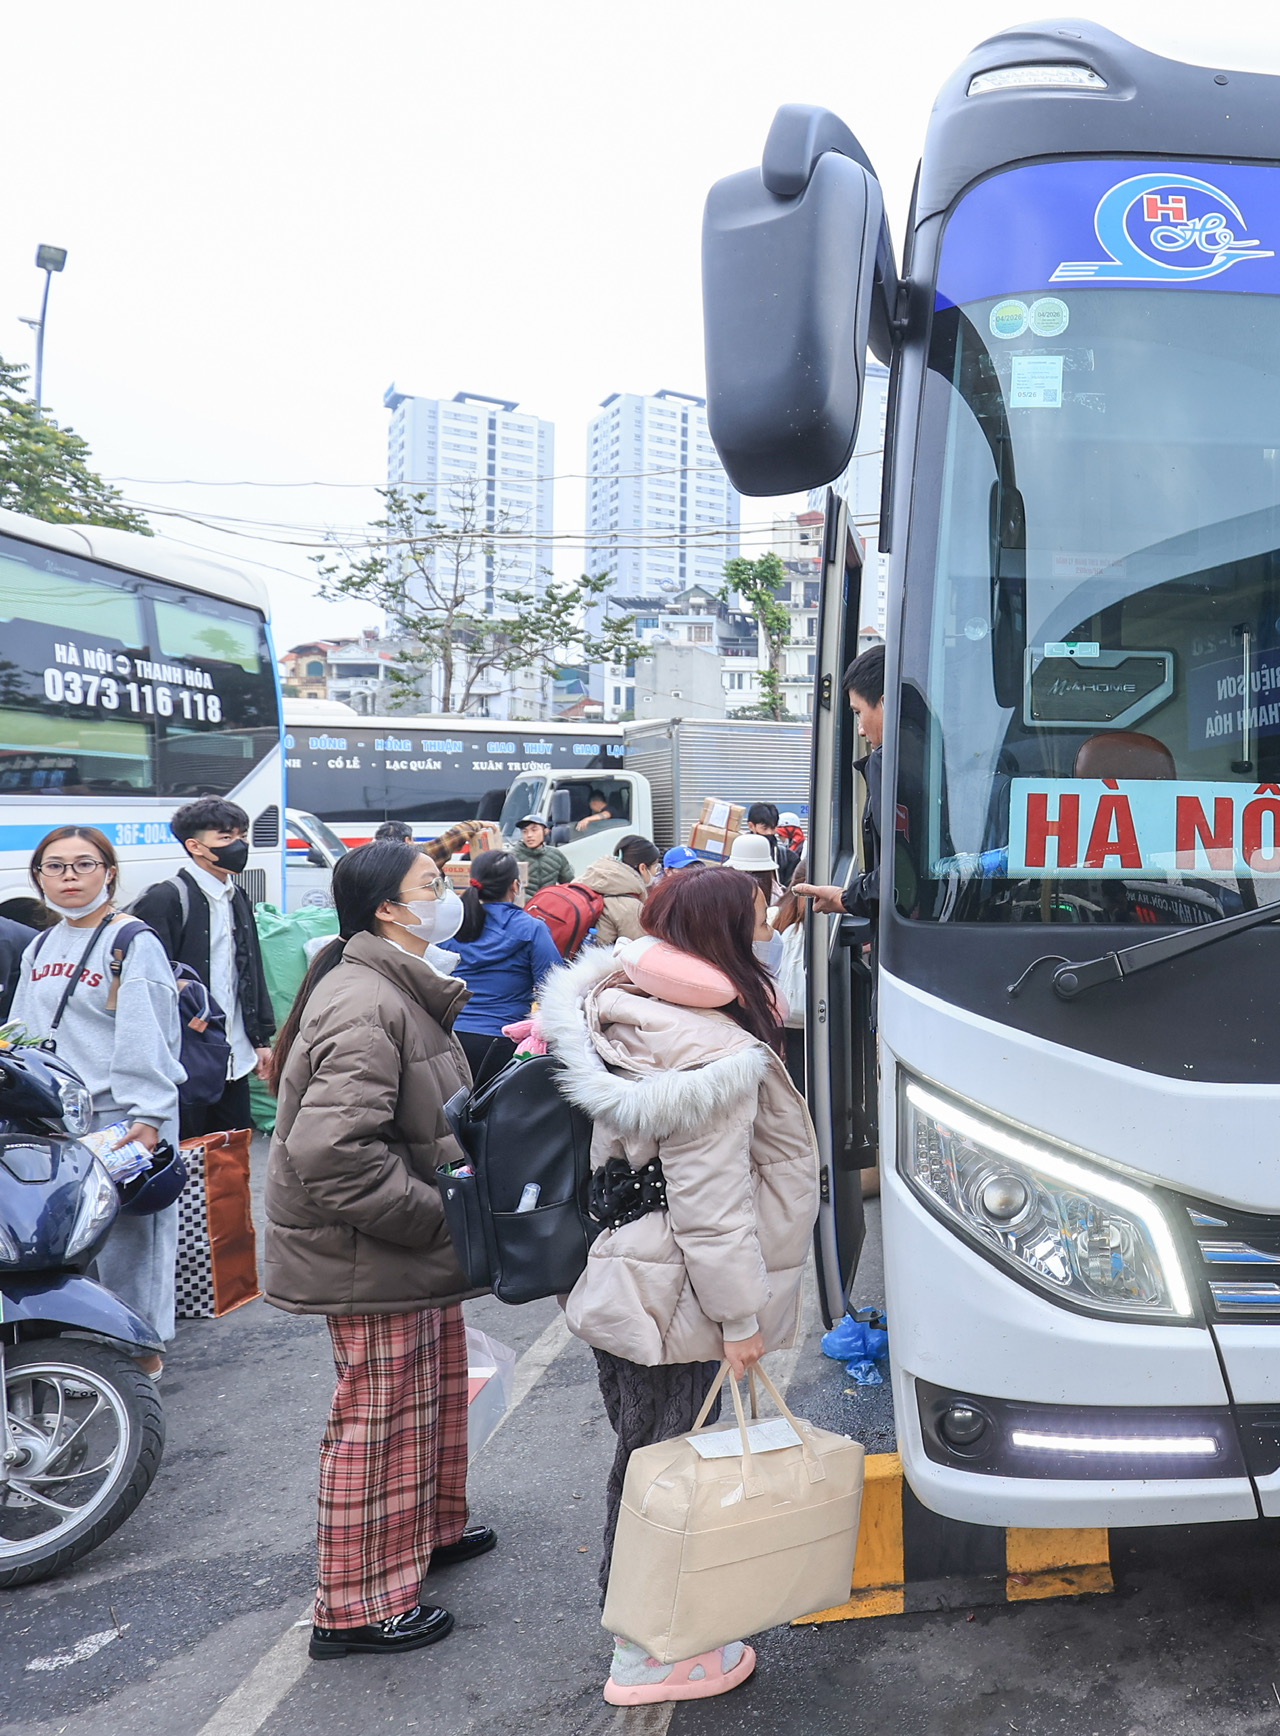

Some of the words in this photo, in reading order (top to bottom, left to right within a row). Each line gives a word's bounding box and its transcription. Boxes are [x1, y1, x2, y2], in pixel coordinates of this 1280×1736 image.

[54, 642, 81, 667] HÀ
[82, 647, 113, 675] NỘI
[134, 658, 183, 685] THANH
[185, 667, 213, 690] HÓA
[43, 667, 120, 710] 0373
[126, 682, 174, 717] 116
[179, 690, 223, 723] 118
[486, 741, 516, 754] GIAO
[572, 743, 600, 756] GIAO
[1024, 778, 1142, 869] HÀ
